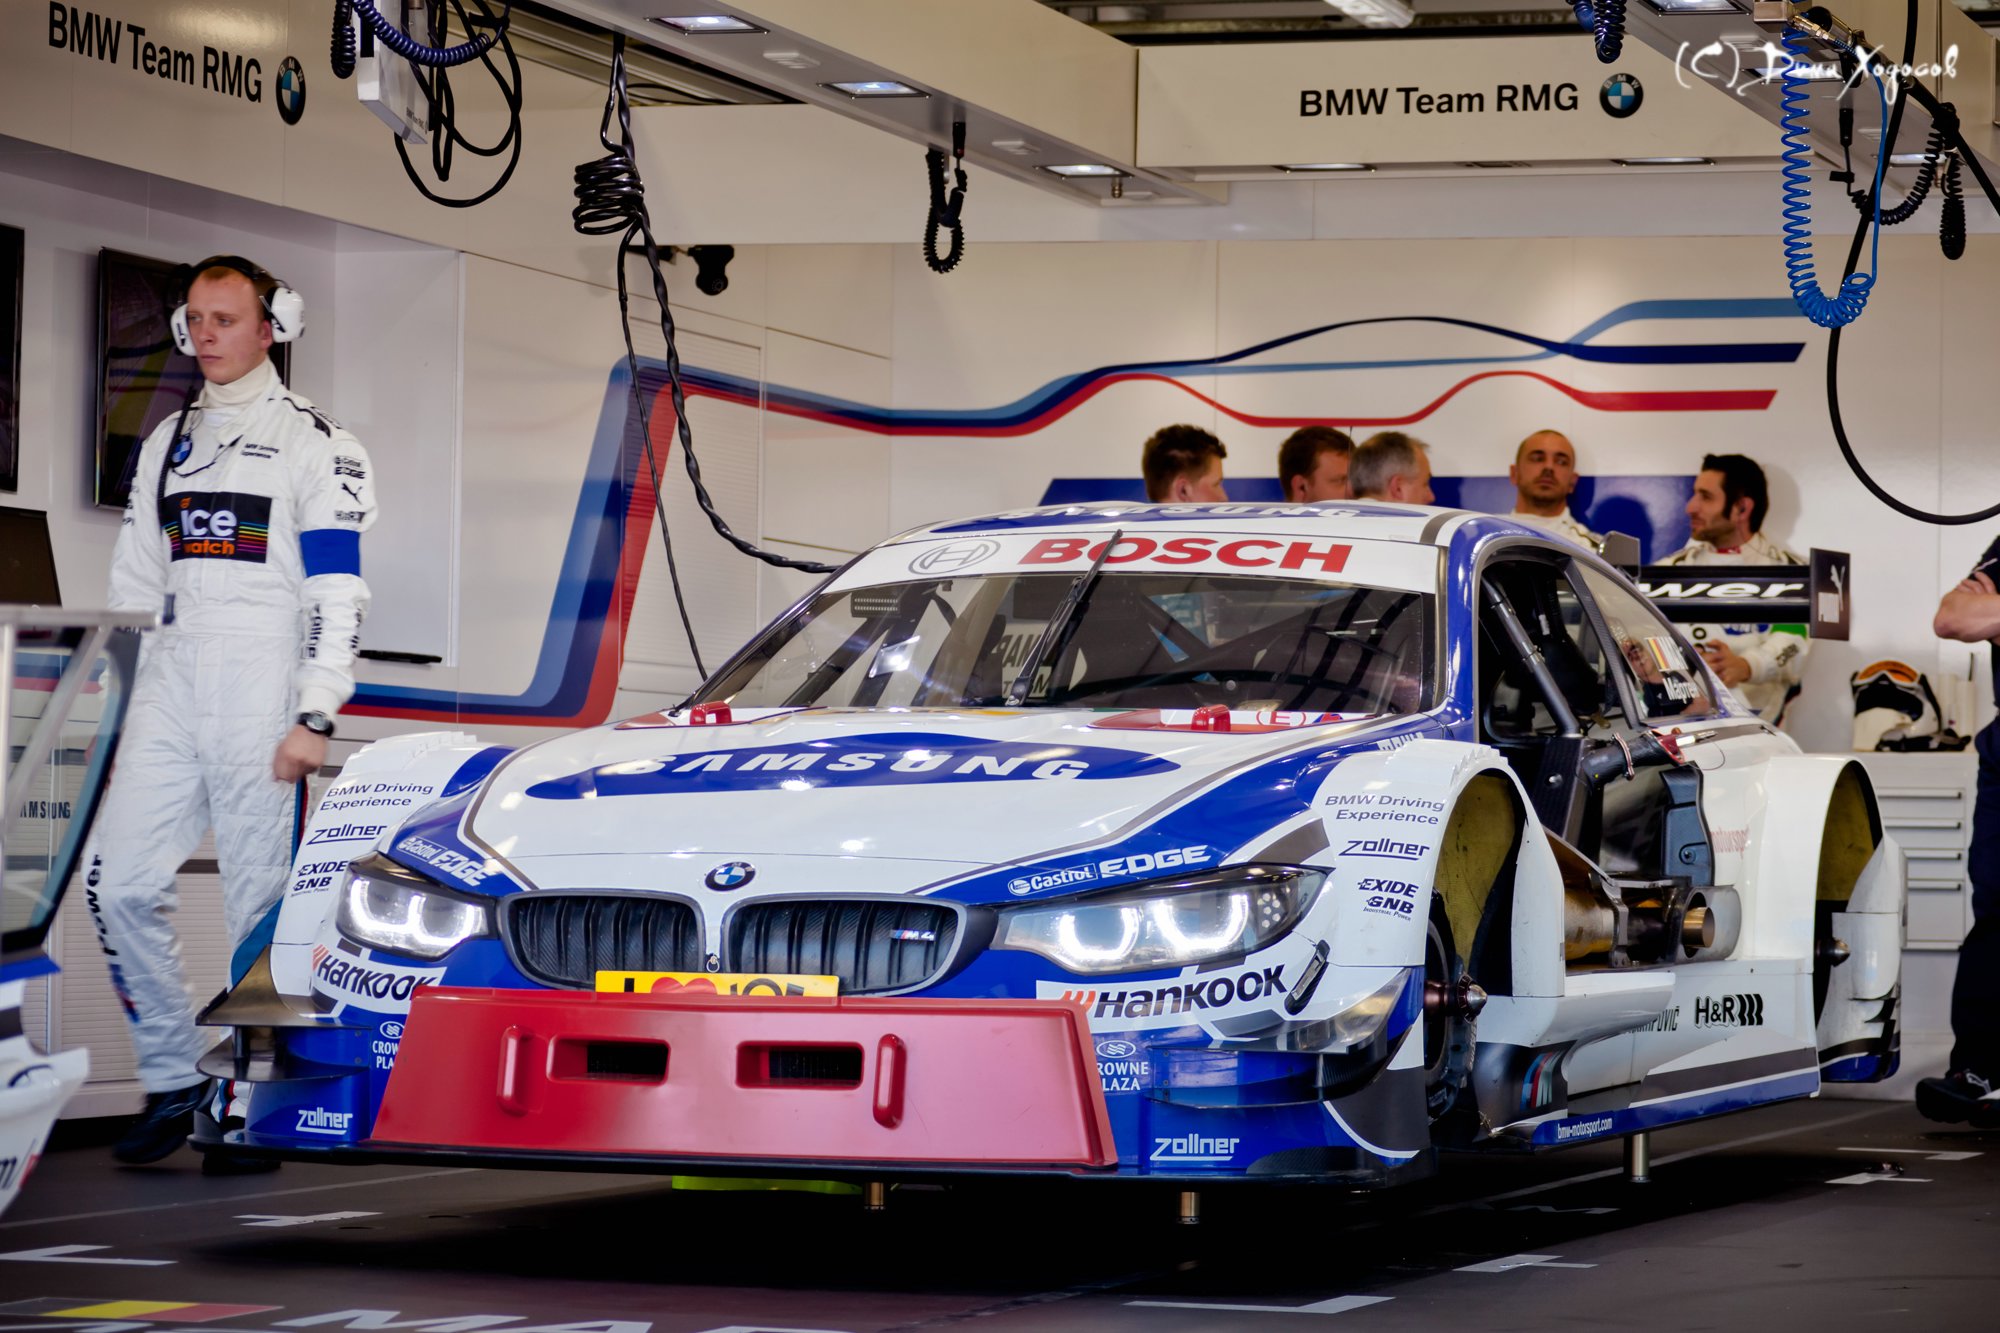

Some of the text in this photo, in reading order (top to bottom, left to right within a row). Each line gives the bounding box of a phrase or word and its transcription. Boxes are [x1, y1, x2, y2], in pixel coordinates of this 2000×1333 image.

[49, 1, 262, 103] BMW Team RMG
[1300, 83, 1578, 116] BMW Team RMG
[180, 509, 238, 537] ice
[1018, 537, 1353, 574] BOSCH
[618, 749, 1090, 781] SAMSUNG
[327, 783, 434, 797] BMW Driving
[20, 801, 71, 819] AMSUNG
[320, 797, 412, 811] Experience
[1325, 795, 1445, 812] BMW Driving
[1336, 809, 1439, 825] Experience
[306, 824, 388, 845] zollner
[1338, 838, 1430, 861] zollner
[297, 861, 348, 877] EXIDE
[1030, 845, 1211, 891] Castrol EDGE
[1358, 878, 1419, 898] EXIDE
[1366, 895, 1414, 914] GNB
[1694, 996, 1736, 1027] H&R
[1097, 1061, 1149, 1075] ROWNE
[1102, 1077, 1141, 1091] LAZA
[296, 1107, 353, 1135] zollner
[1557, 1117, 1612, 1139] bmw-motorsport.com
[1150, 1133, 1240, 1161] zollner
